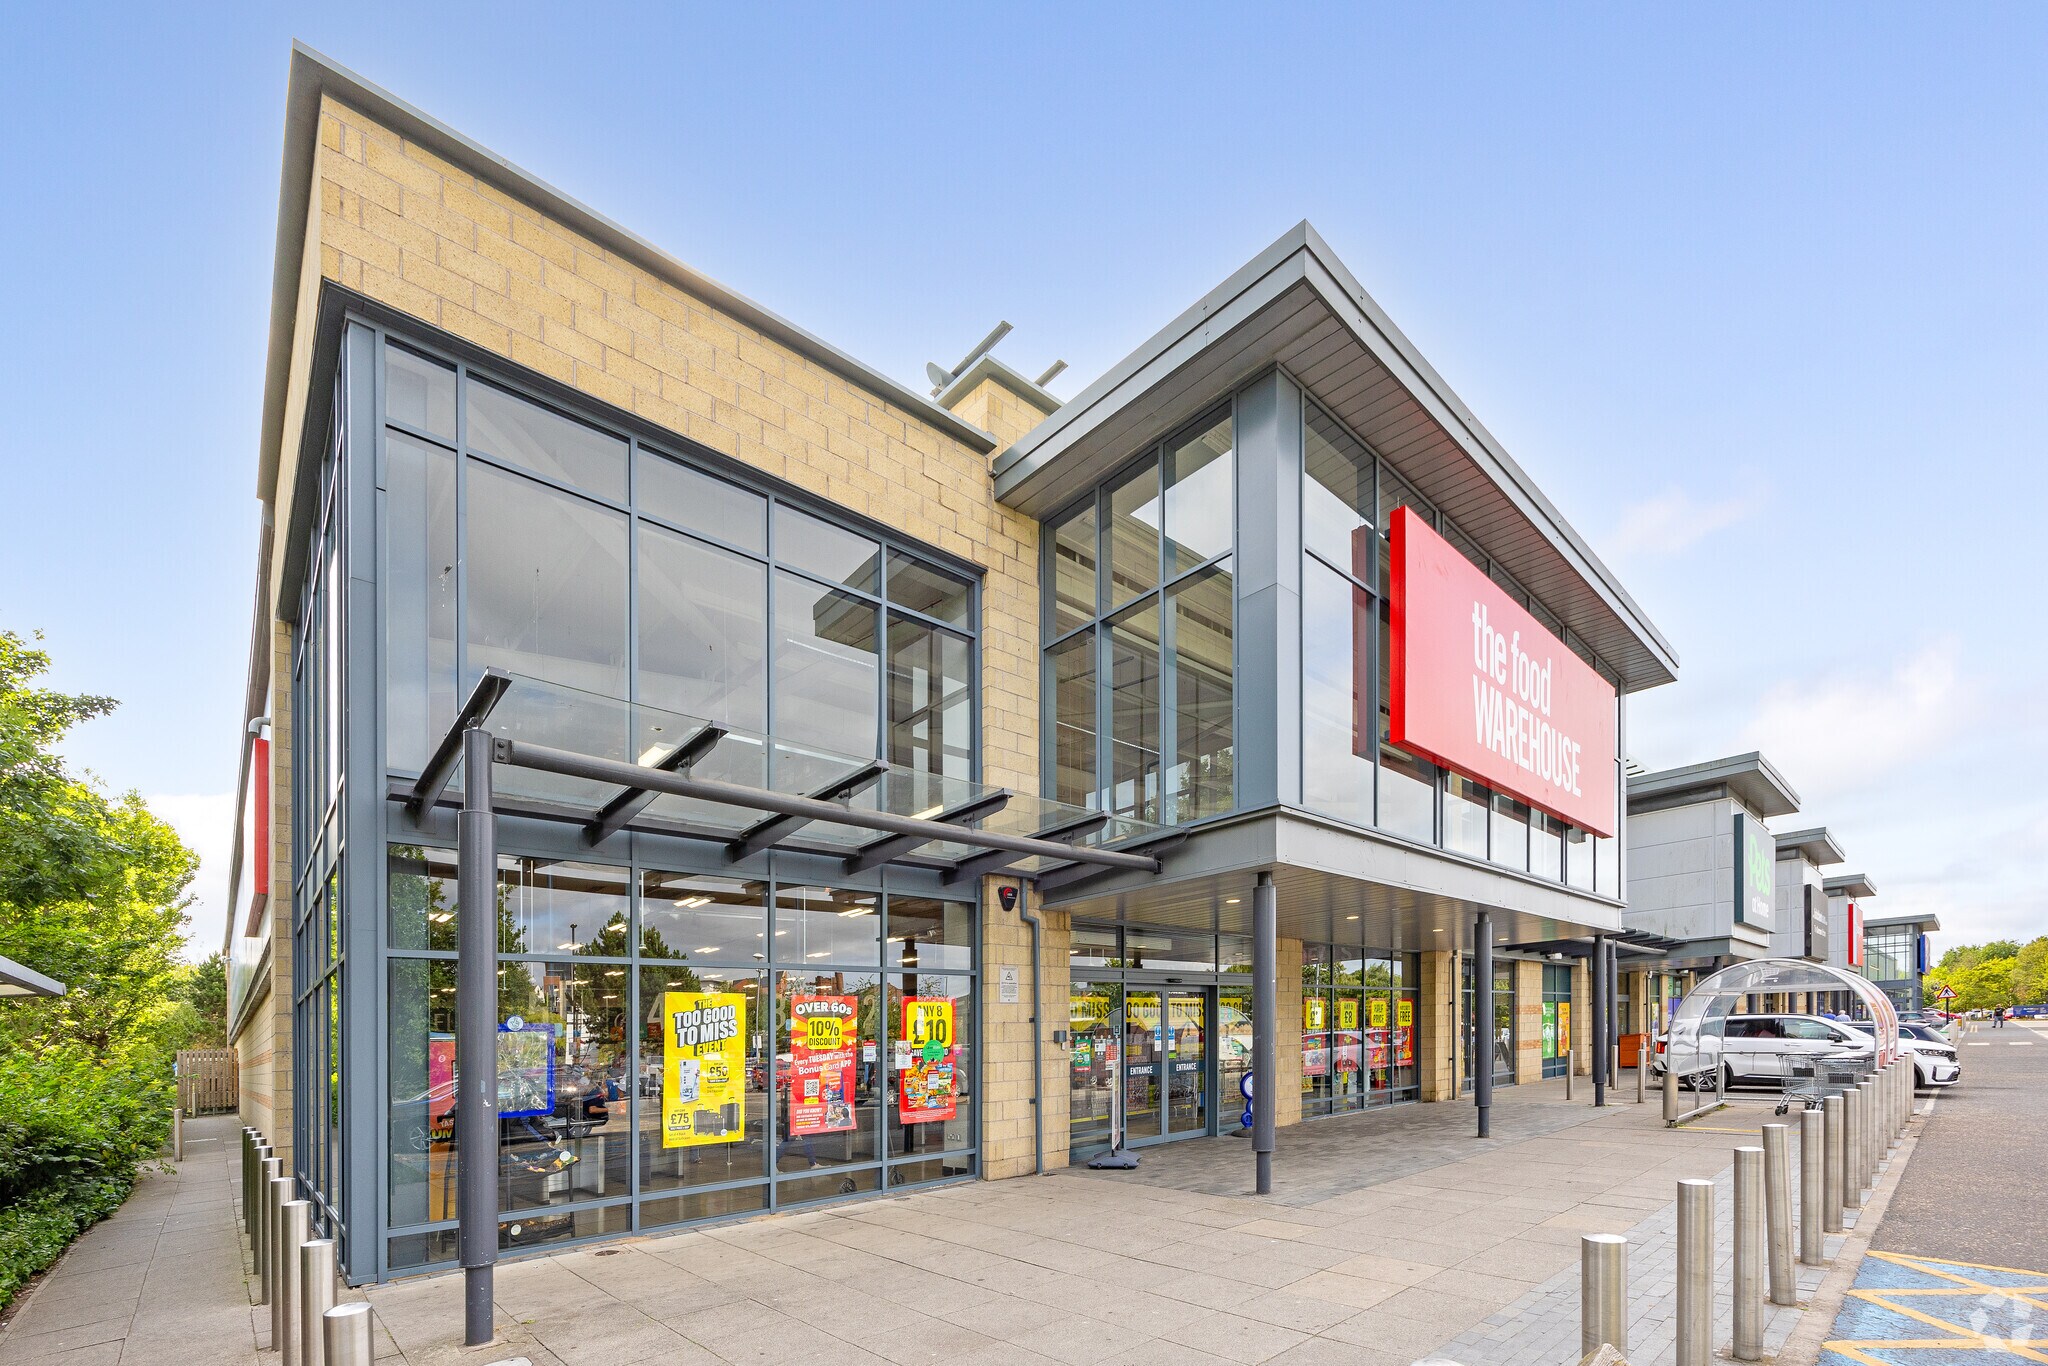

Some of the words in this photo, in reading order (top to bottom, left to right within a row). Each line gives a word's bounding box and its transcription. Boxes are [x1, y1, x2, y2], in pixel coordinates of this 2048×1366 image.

[1472, 601, 1507, 685] the
[1511, 630, 1551, 717] food
[1473, 674, 1582, 798] WAREHOUSE
[1748, 834, 1771, 896] Pets
[1757, 896, 1769, 918] Home
[695, 998, 712, 1009] THE
[795, 1001, 829, 1015] OVER
[831, 1001, 853, 1015] 60s
[937, 1005, 943, 1017] 8
[1126, 1002, 1140, 1018] OO
[673, 1009, 701, 1029] TOO
[703, 1005, 736, 1025] GOOD
[1344, 1011, 1353, 1023] £8
[1400, 1011, 1410, 1022] FREE
[677, 1026, 699, 1048] TO
[700, 1019, 738, 1043] MISS
[809, 1020, 840, 1036] 10%
[695, 1038, 727, 1056] EVENT
[809, 1037, 841, 1046] DISCOUNT
[794, 1059, 809, 1067] Every
[808, 1052, 834, 1064] TUESDAY
[1176, 1062, 1197, 1071] ENTRANCE
[798, 1065, 823, 1075] Bonus
[840, 1060, 852, 1068] APP
[1130, 1065, 1153, 1075] ENTRANCE
[670, 1113, 690, 1125] £75
